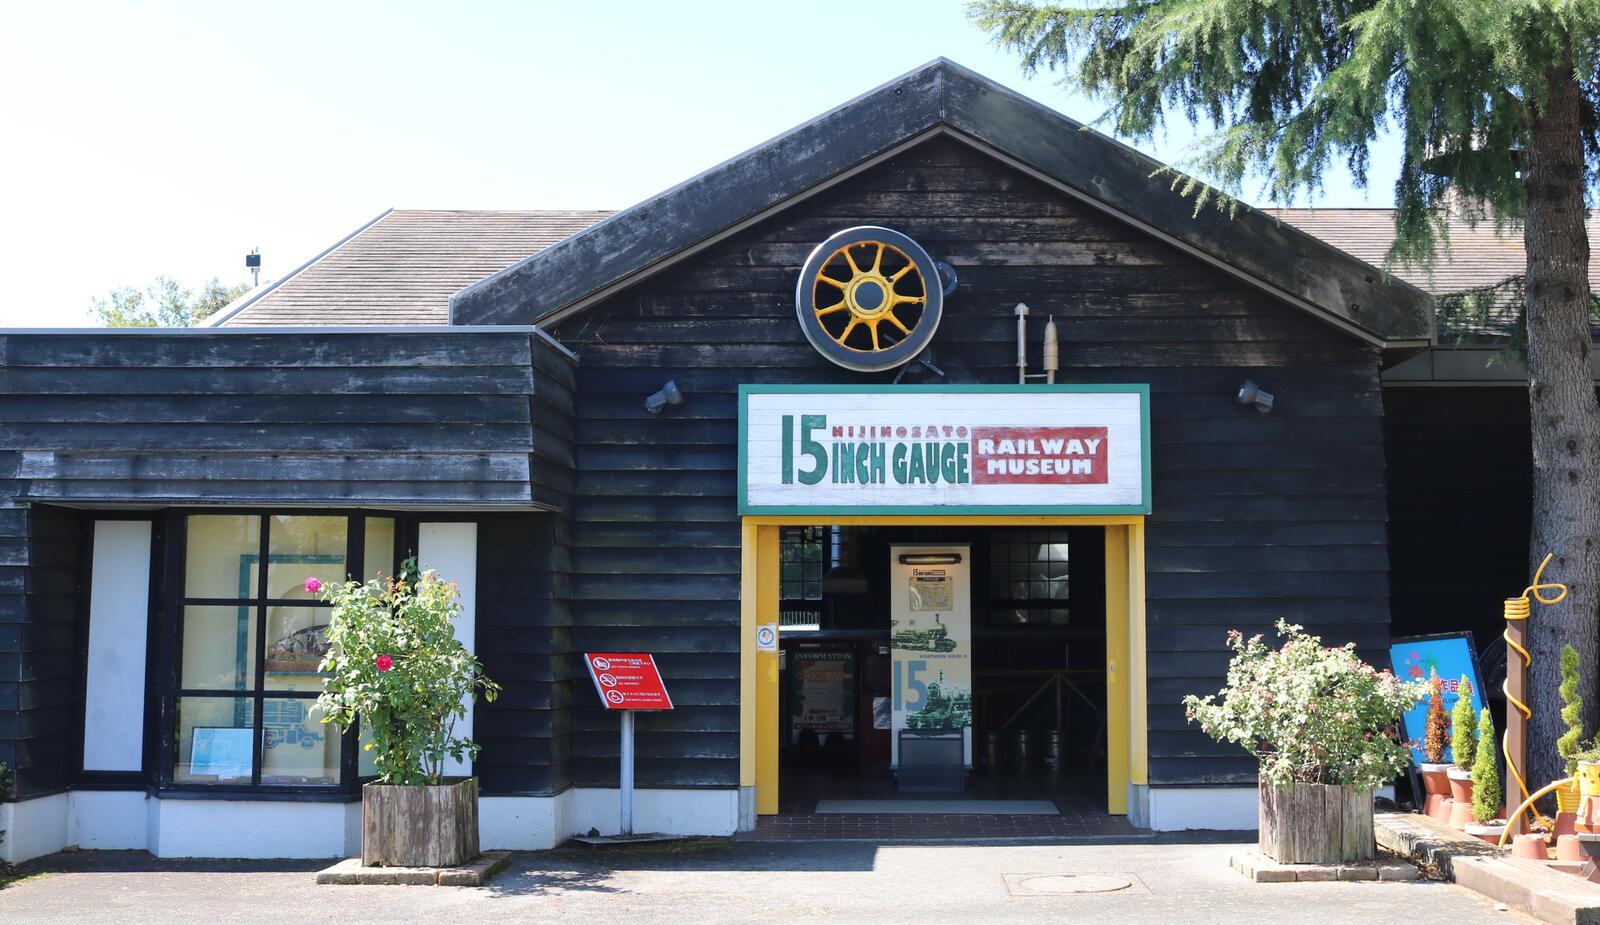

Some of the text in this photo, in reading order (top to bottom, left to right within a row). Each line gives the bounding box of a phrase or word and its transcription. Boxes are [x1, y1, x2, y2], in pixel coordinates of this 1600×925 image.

[832, 426, 968, 438] NIJINOSATO
[782, 415, 969, 485] 15 INCH GAUGE
[978, 439, 1101, 455] RAILWAY
[987, 459, 1092, 475] MUSEUM
[894, 660, 927, 711] 15
